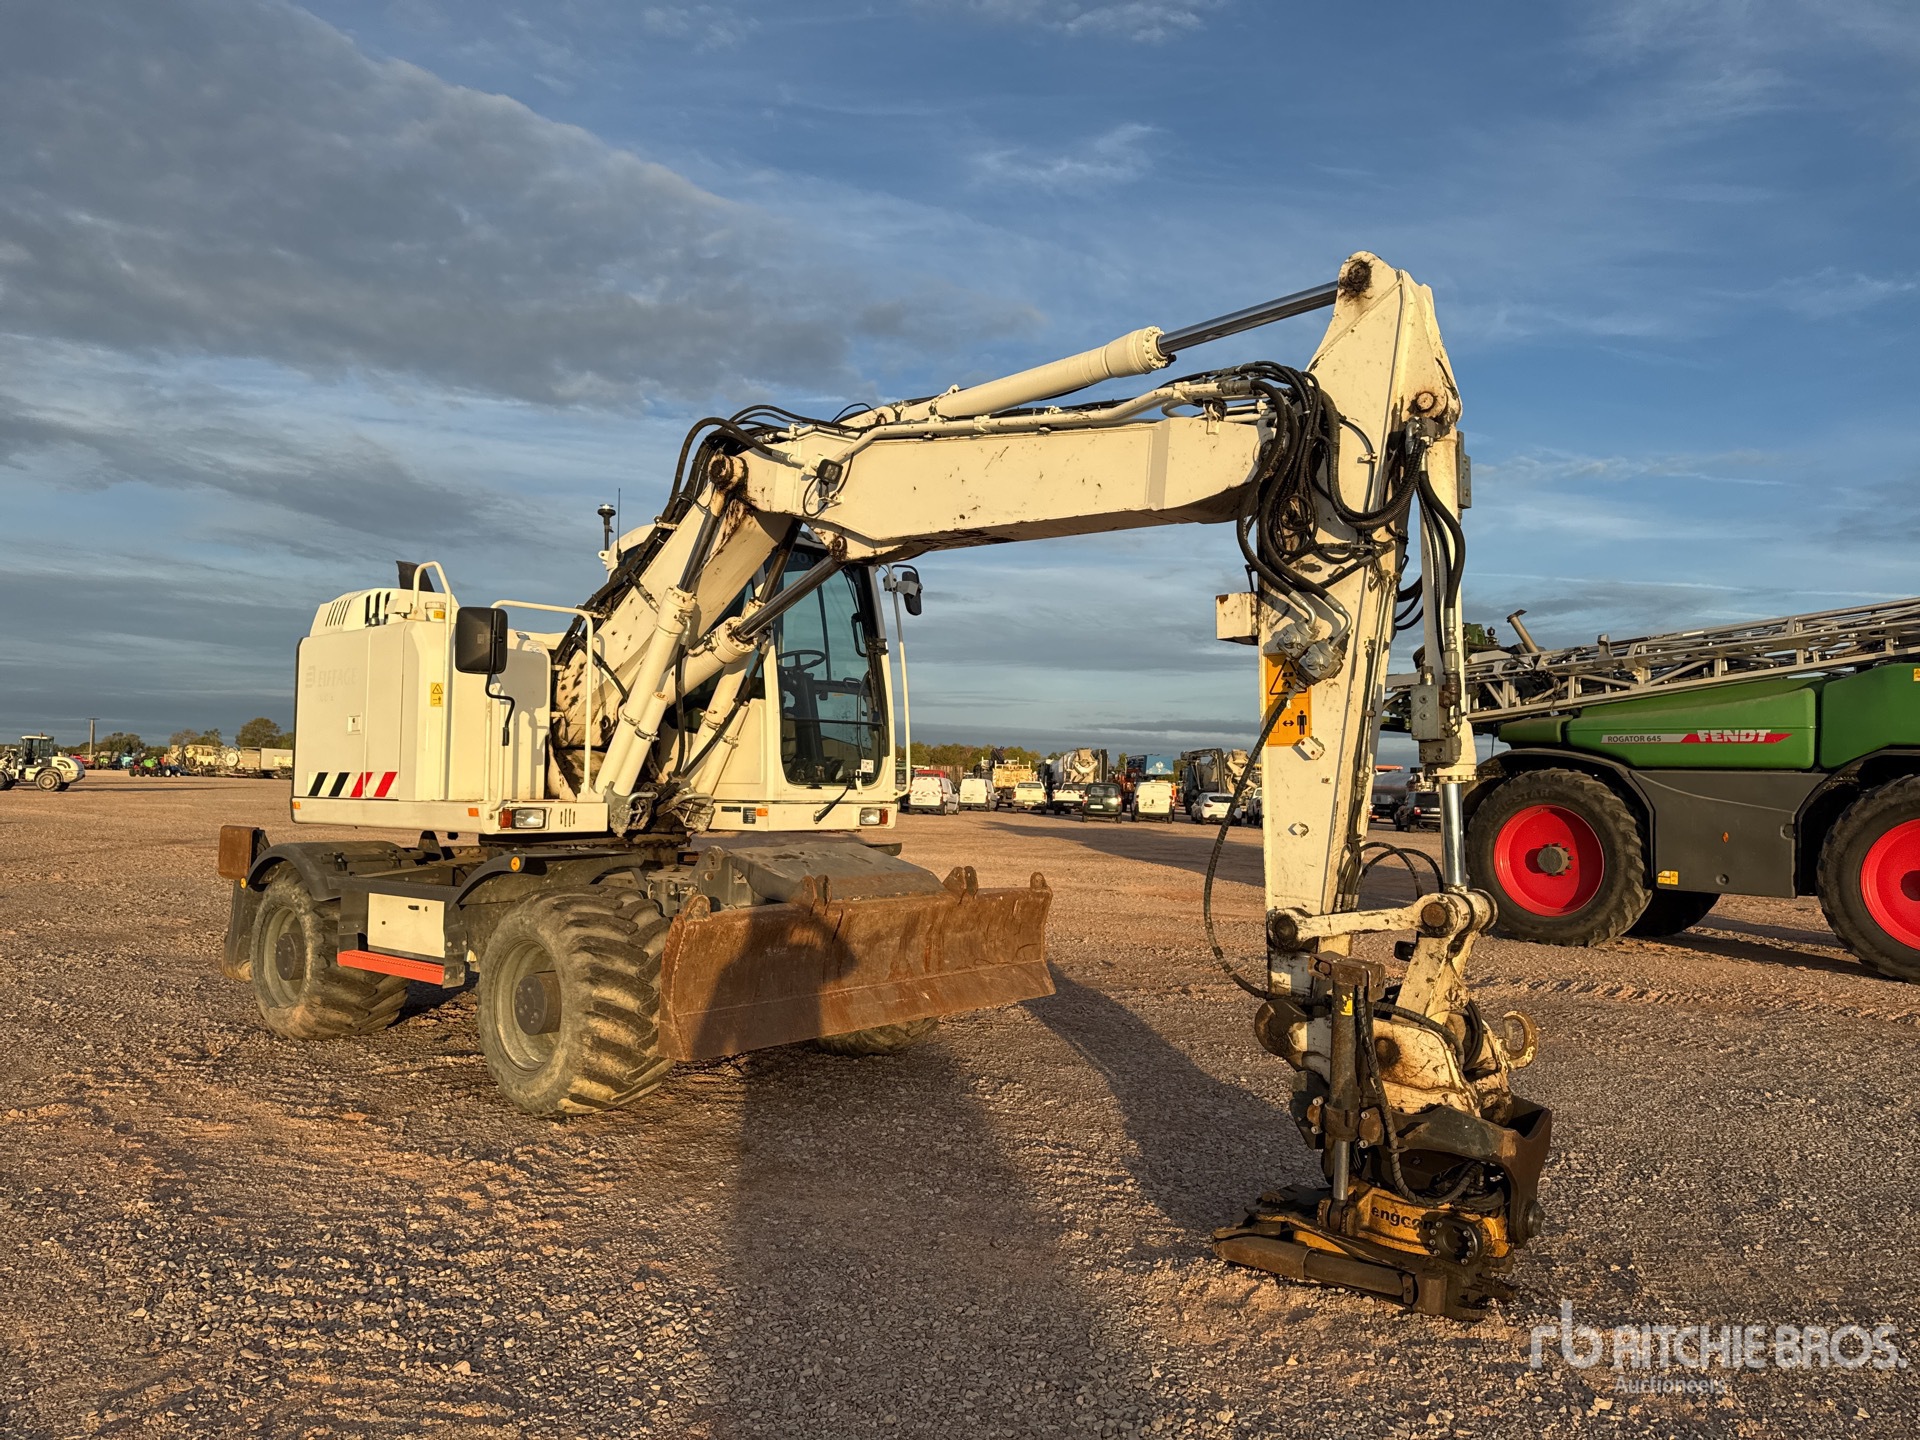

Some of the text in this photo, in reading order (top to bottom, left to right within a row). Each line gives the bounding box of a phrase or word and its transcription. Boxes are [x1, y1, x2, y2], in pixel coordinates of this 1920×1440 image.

[1607, 734, 1662, 743] ROGATOR 645
[1697, 729, 1771, 742] FENDT
